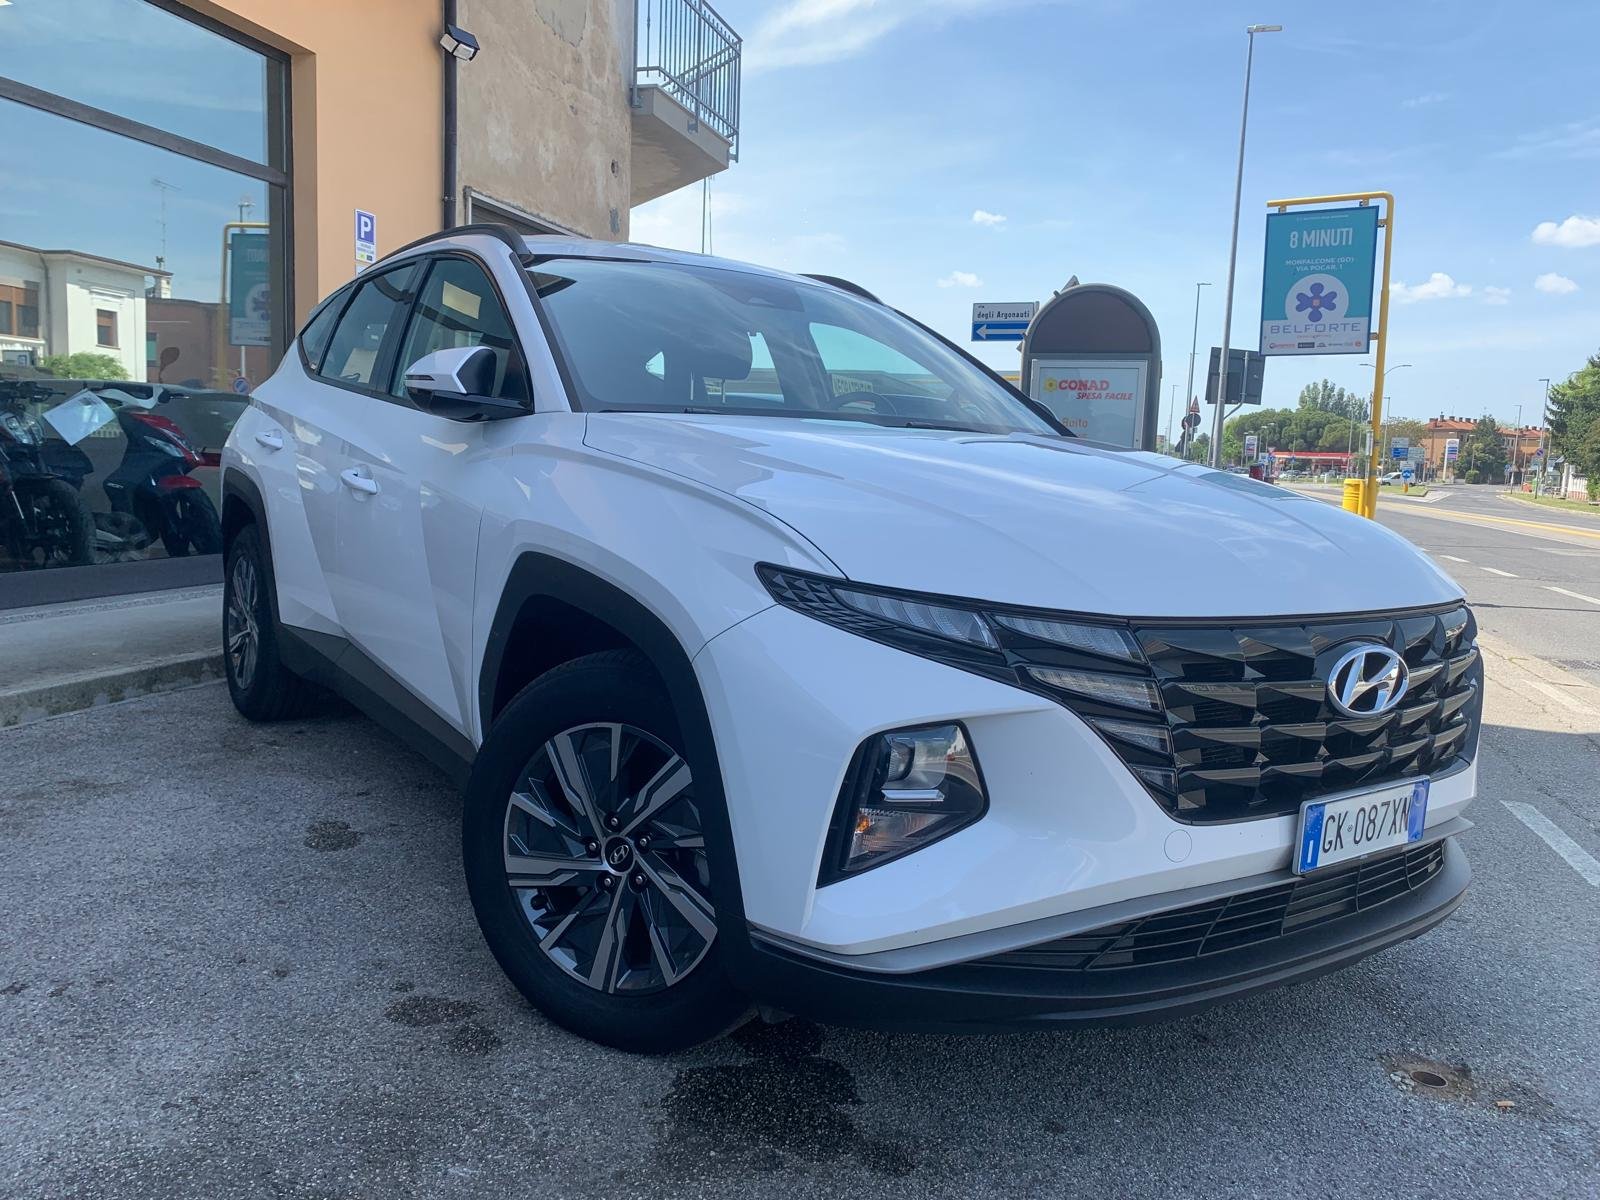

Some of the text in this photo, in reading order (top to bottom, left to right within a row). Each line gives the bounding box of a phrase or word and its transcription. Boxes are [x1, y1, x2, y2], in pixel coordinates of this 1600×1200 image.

[1289, 227, 1353, 249] 8 MINUTI
[977, 310, 1030, 319] degli Argonauti
[1270, 323, 1360, 334] BELFORTE
[1058, 380, 1110, 391] CONAD
[1076, 392, 1102, 400] SPESA
[1322, 811, 1348, 853] GK
